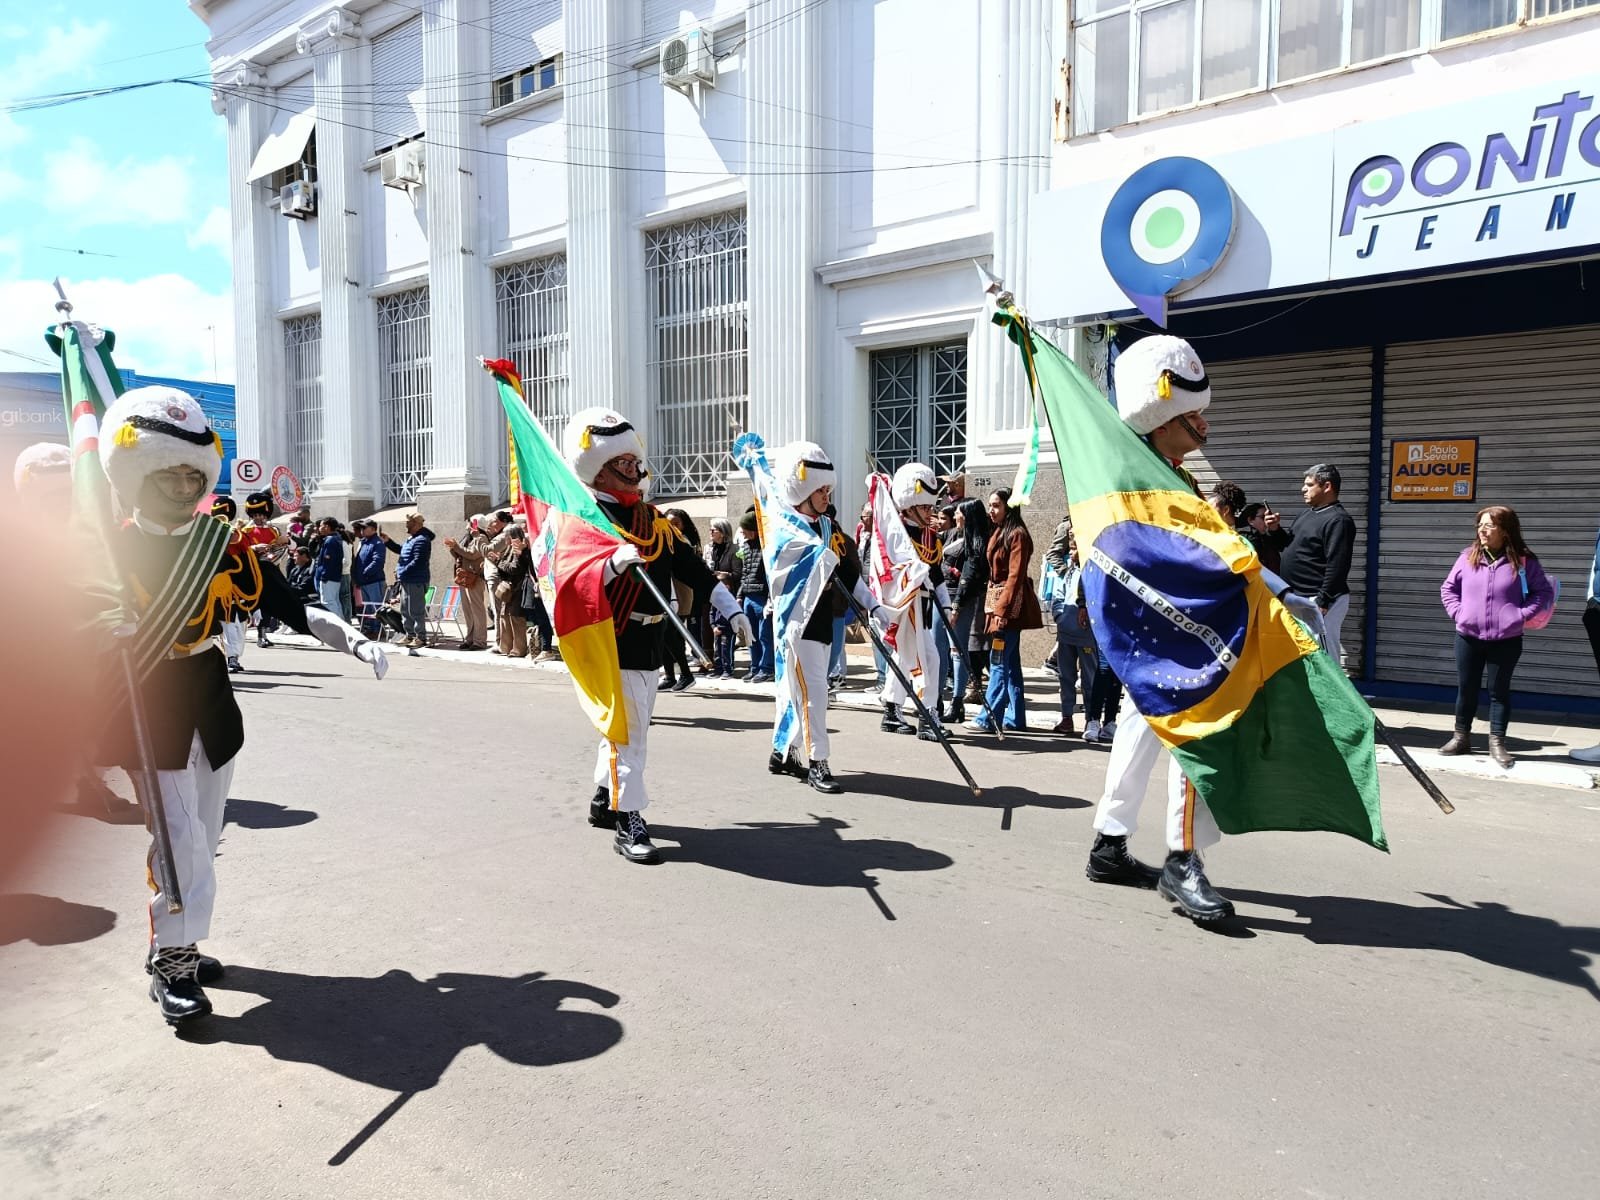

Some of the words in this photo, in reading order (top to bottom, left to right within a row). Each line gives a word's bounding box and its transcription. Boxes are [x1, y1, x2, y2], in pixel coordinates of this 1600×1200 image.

[1423, 452, 1458, 461] Severo
[244, 464, 254, 478] E
[1396, 463, 1471, 476] ALUGUE
[1093, 550, 1131, 585] ORDEM
[1137, 585, 1148, 596] E
[1153, 600, 1233, 663] PROGRESSO
